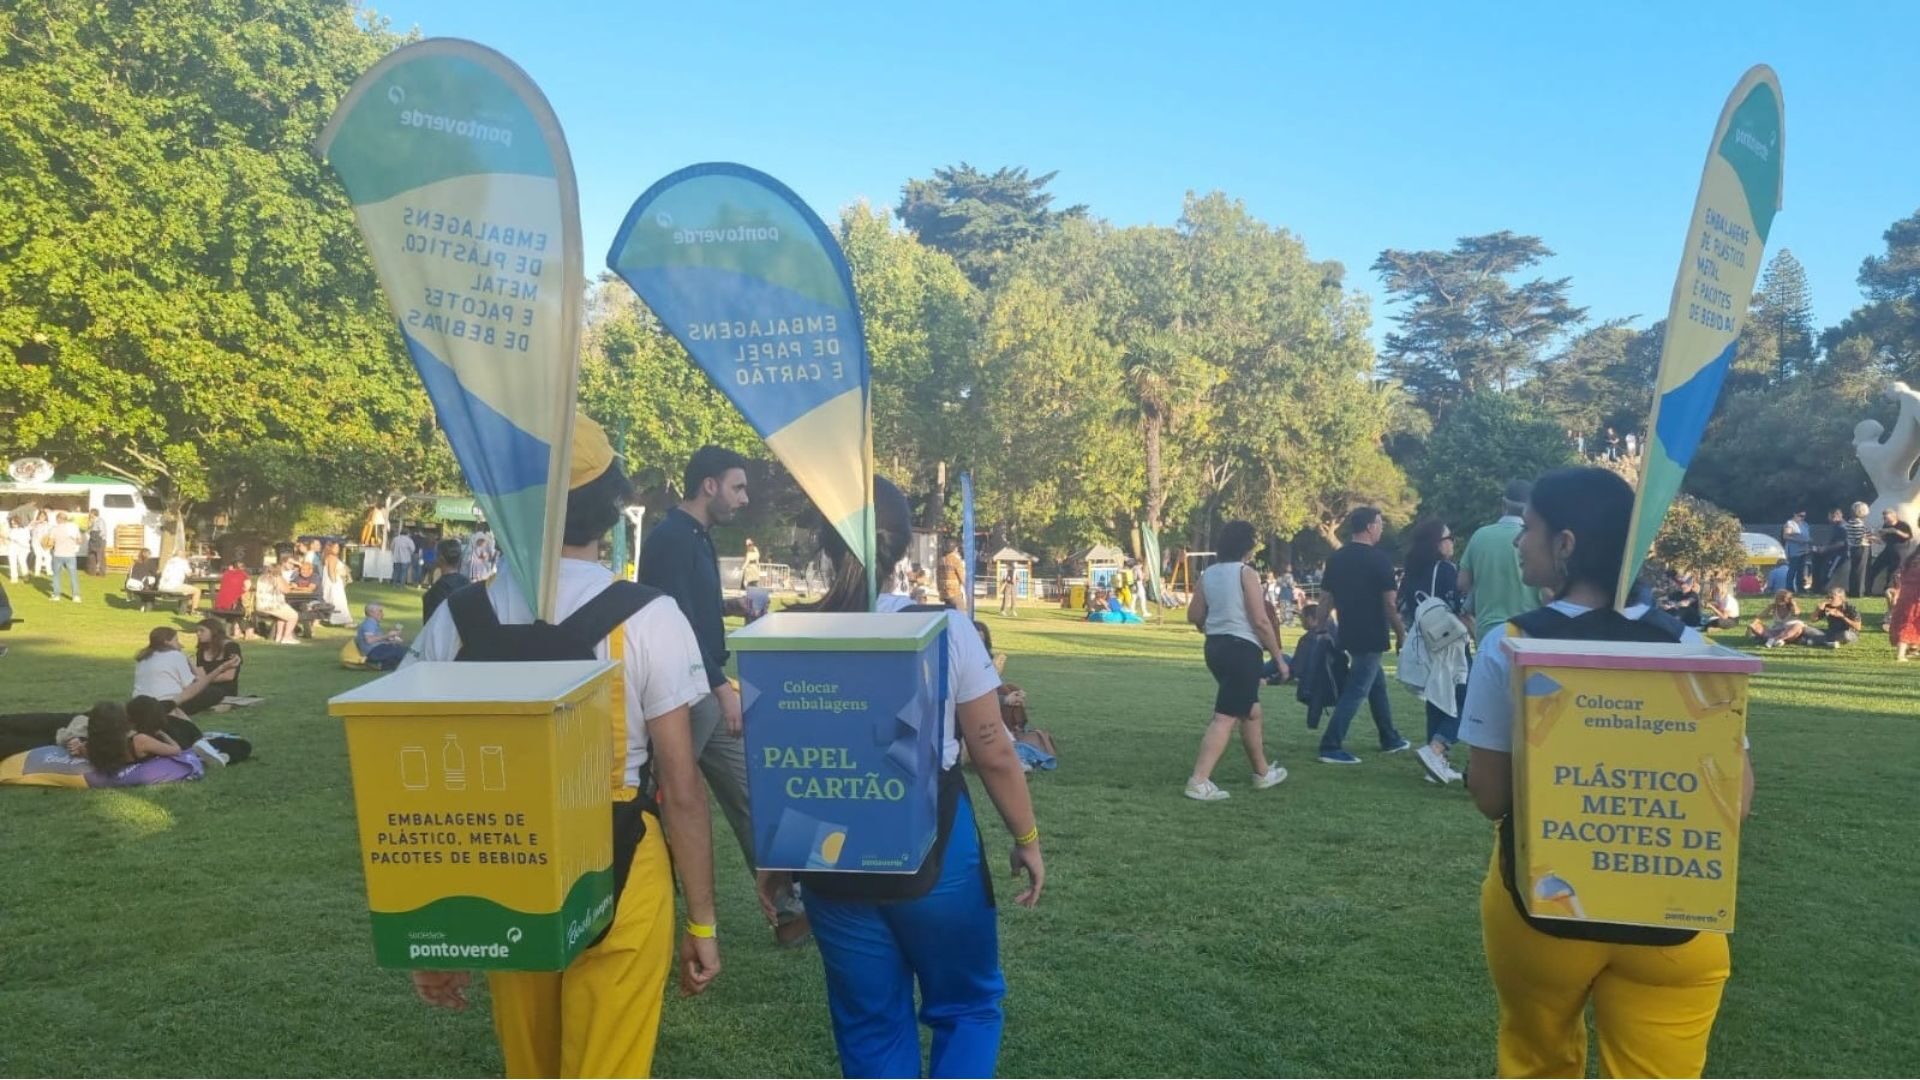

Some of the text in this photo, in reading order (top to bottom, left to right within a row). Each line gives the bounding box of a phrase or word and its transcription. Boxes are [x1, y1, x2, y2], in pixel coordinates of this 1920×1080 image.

[1705, 207, 1750, 246] EMBALAGENS
[1700, 231, 1711, 252] DE
[1697, 255, 1720, 282] METAL
[1693, 278, 1732, 310] E PACOTES
[1689, 303, 1700, 322] DE
[783, 680, 839, 694] Colocar
[778, 697, 869, 714] embalagens
[1575, 694, 1644, 711] Colocar
[1584, 714, 1697, 735] embalagens
[763, 746, 857, 769] PAPEL
[785, 772, 905, 801] CARTÃO
[1553, 762, 1698, 793] PLÁSTICO
[1581, 795, 1686, 820] METAL
[387, 813, 525, 826] EMBALAGENS DE
[378, 829, 538, 846] PLÁSTICO, METAL E
[1542, 820, 1722, 851] PACOTES DE
[371, 851, 548, 865] PACOTES DE BEBIDAS
[1592, 850, 1723, 881] BEBIDAS
[409, 942, 510, 959] pontoverde
